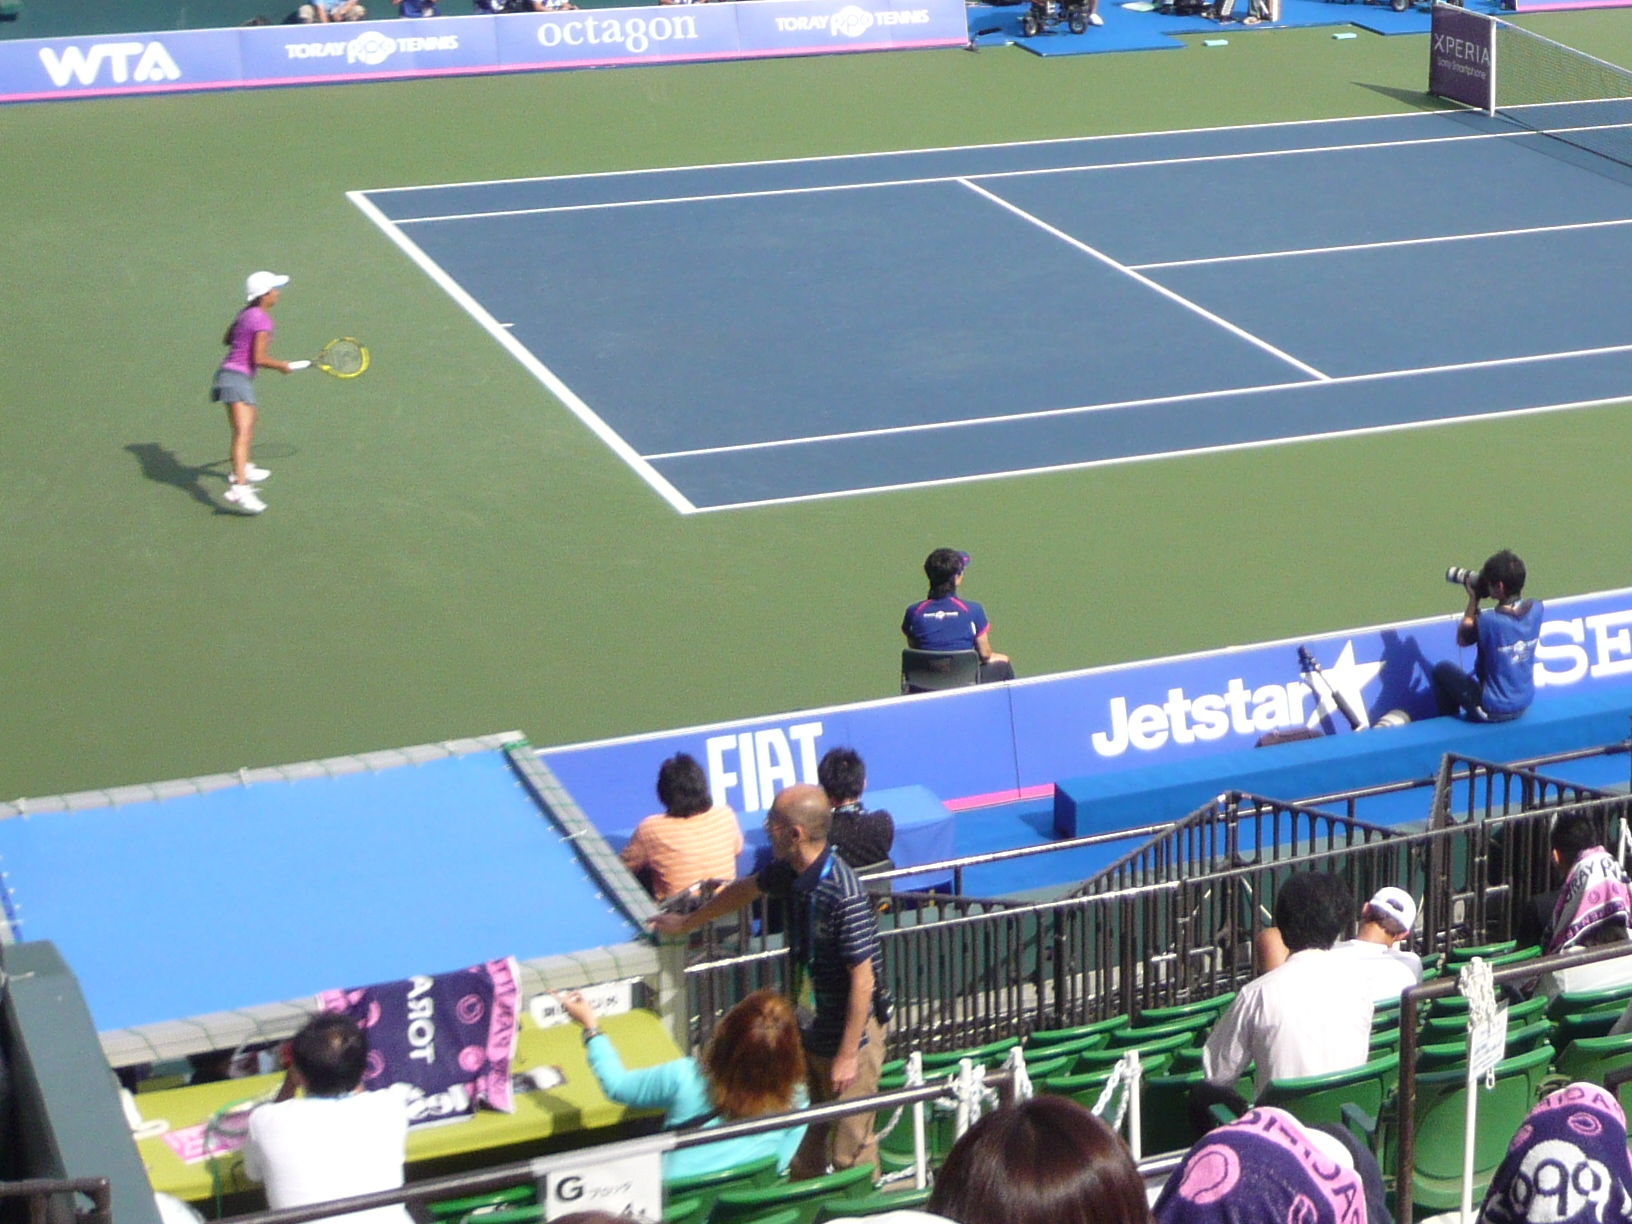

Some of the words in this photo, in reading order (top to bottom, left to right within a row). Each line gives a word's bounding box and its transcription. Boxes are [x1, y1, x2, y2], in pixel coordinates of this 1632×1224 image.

[537, 14, 699, 53] octagon
[775, 14, 829, 33] TORAY
[876, 9, 930, 27] TENNIS
[38, 40, 182, 87] WTA
[284, 40, 347, 61] TORAY
[398, 35, 459, 53] TENNIS
[1434, 33, 1491, 65] XPERIA
[1091, 678, 1315, 757] Jetstar
[706, 721, 824, 813] FIAT
[555, 1175, 585, 1202] G
